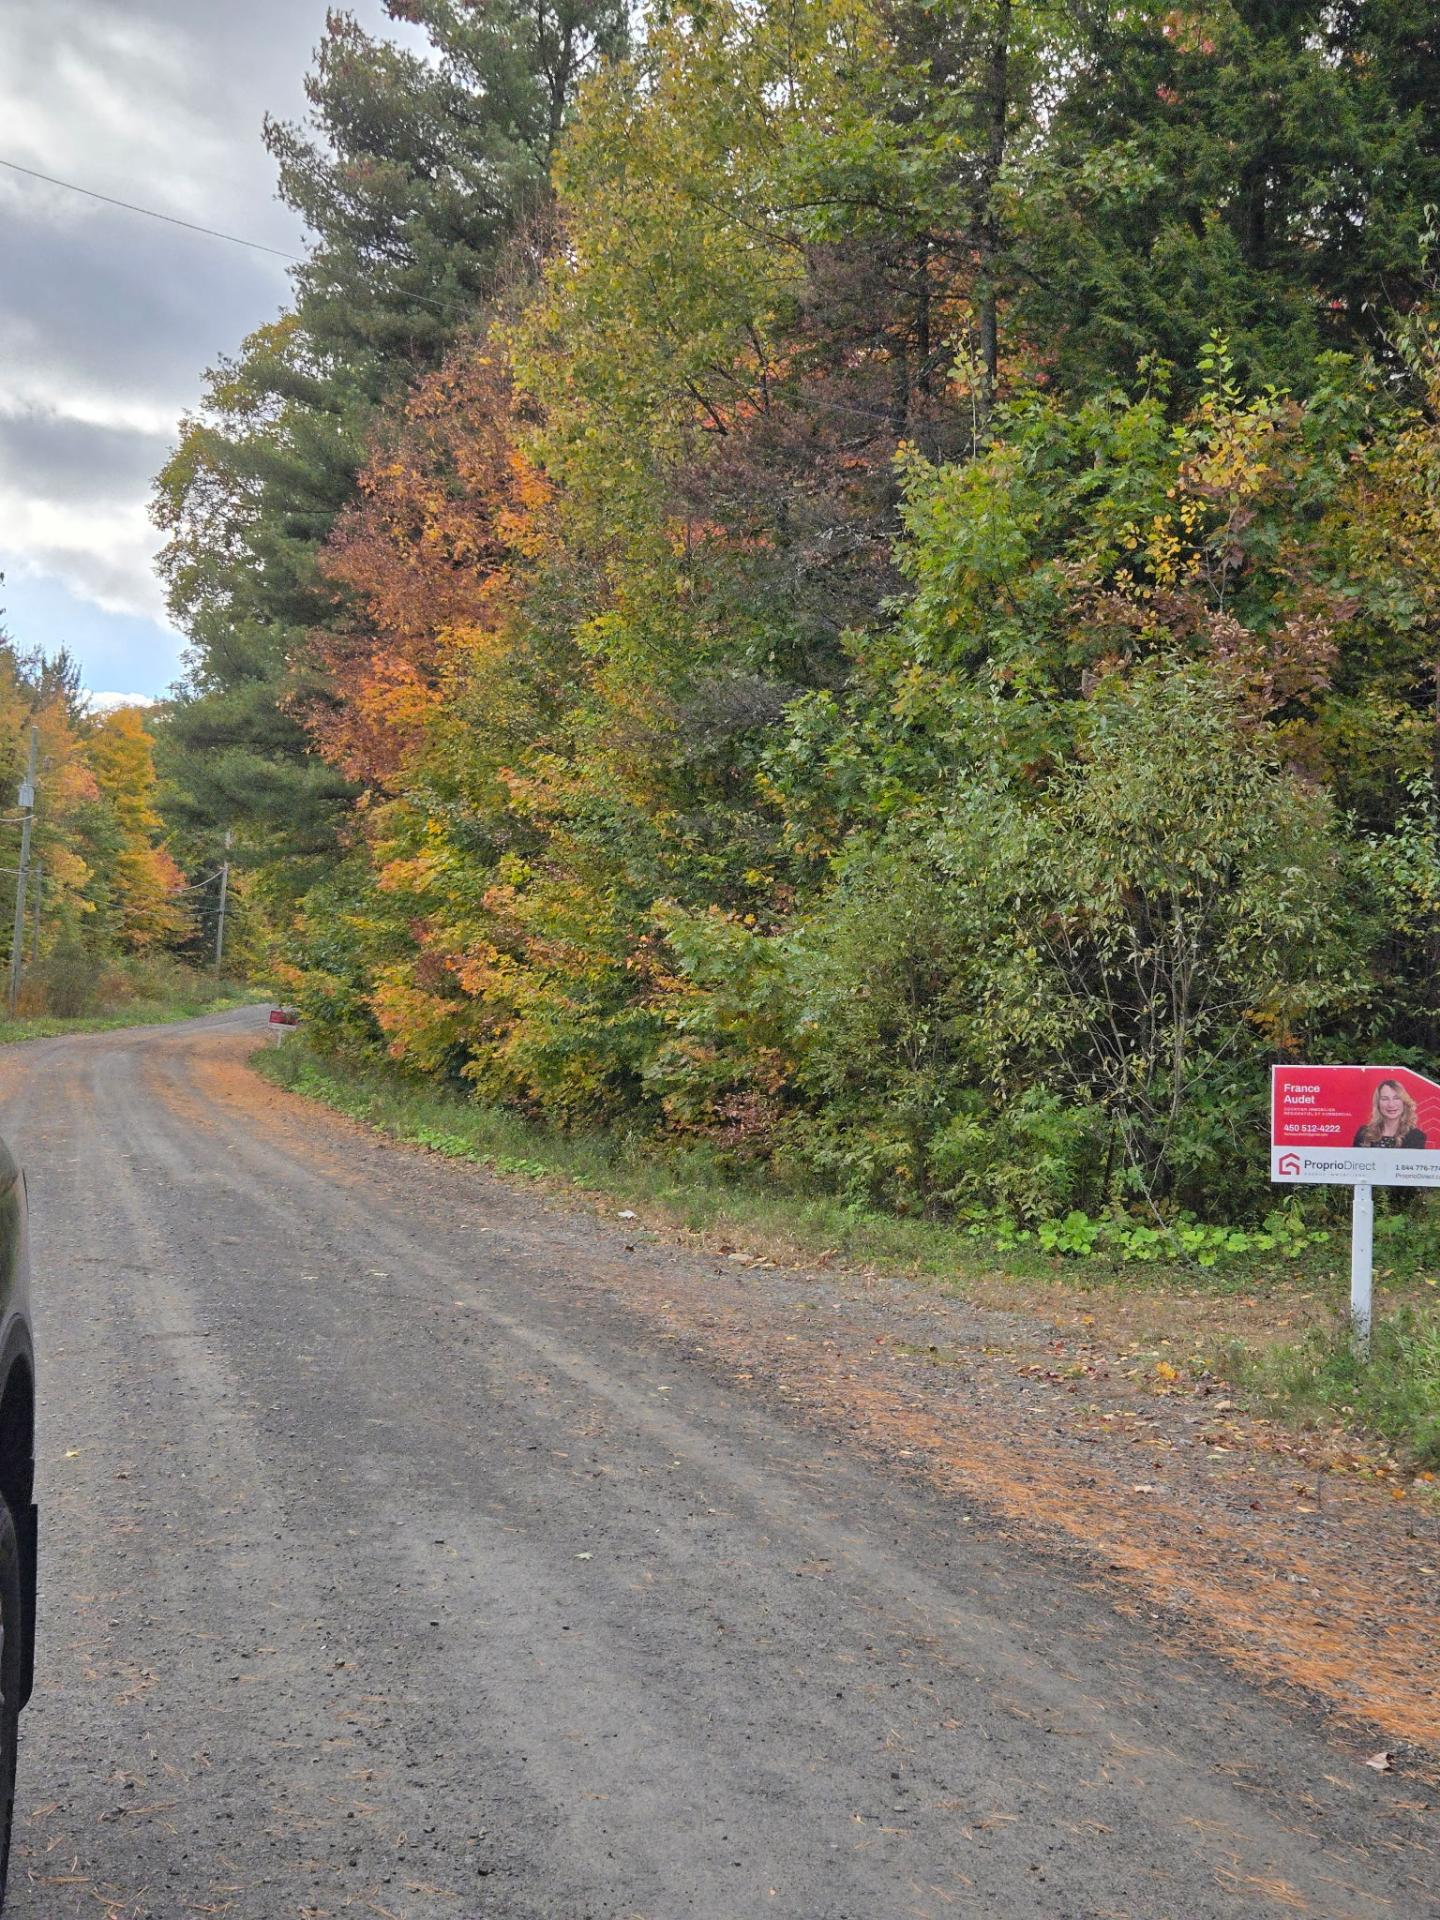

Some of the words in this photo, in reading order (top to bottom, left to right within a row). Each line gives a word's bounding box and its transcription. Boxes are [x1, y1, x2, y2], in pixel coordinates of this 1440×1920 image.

[1283, 1083, 1321, 1093] France
[1283, 1094, 1315, 1105] Audet
[1283, 1124, 1300, 1132] 450
[1301, 1124, 1341, 1133] 512-4222
[1304, 1159, 1377, 1172] ProprioDirect
